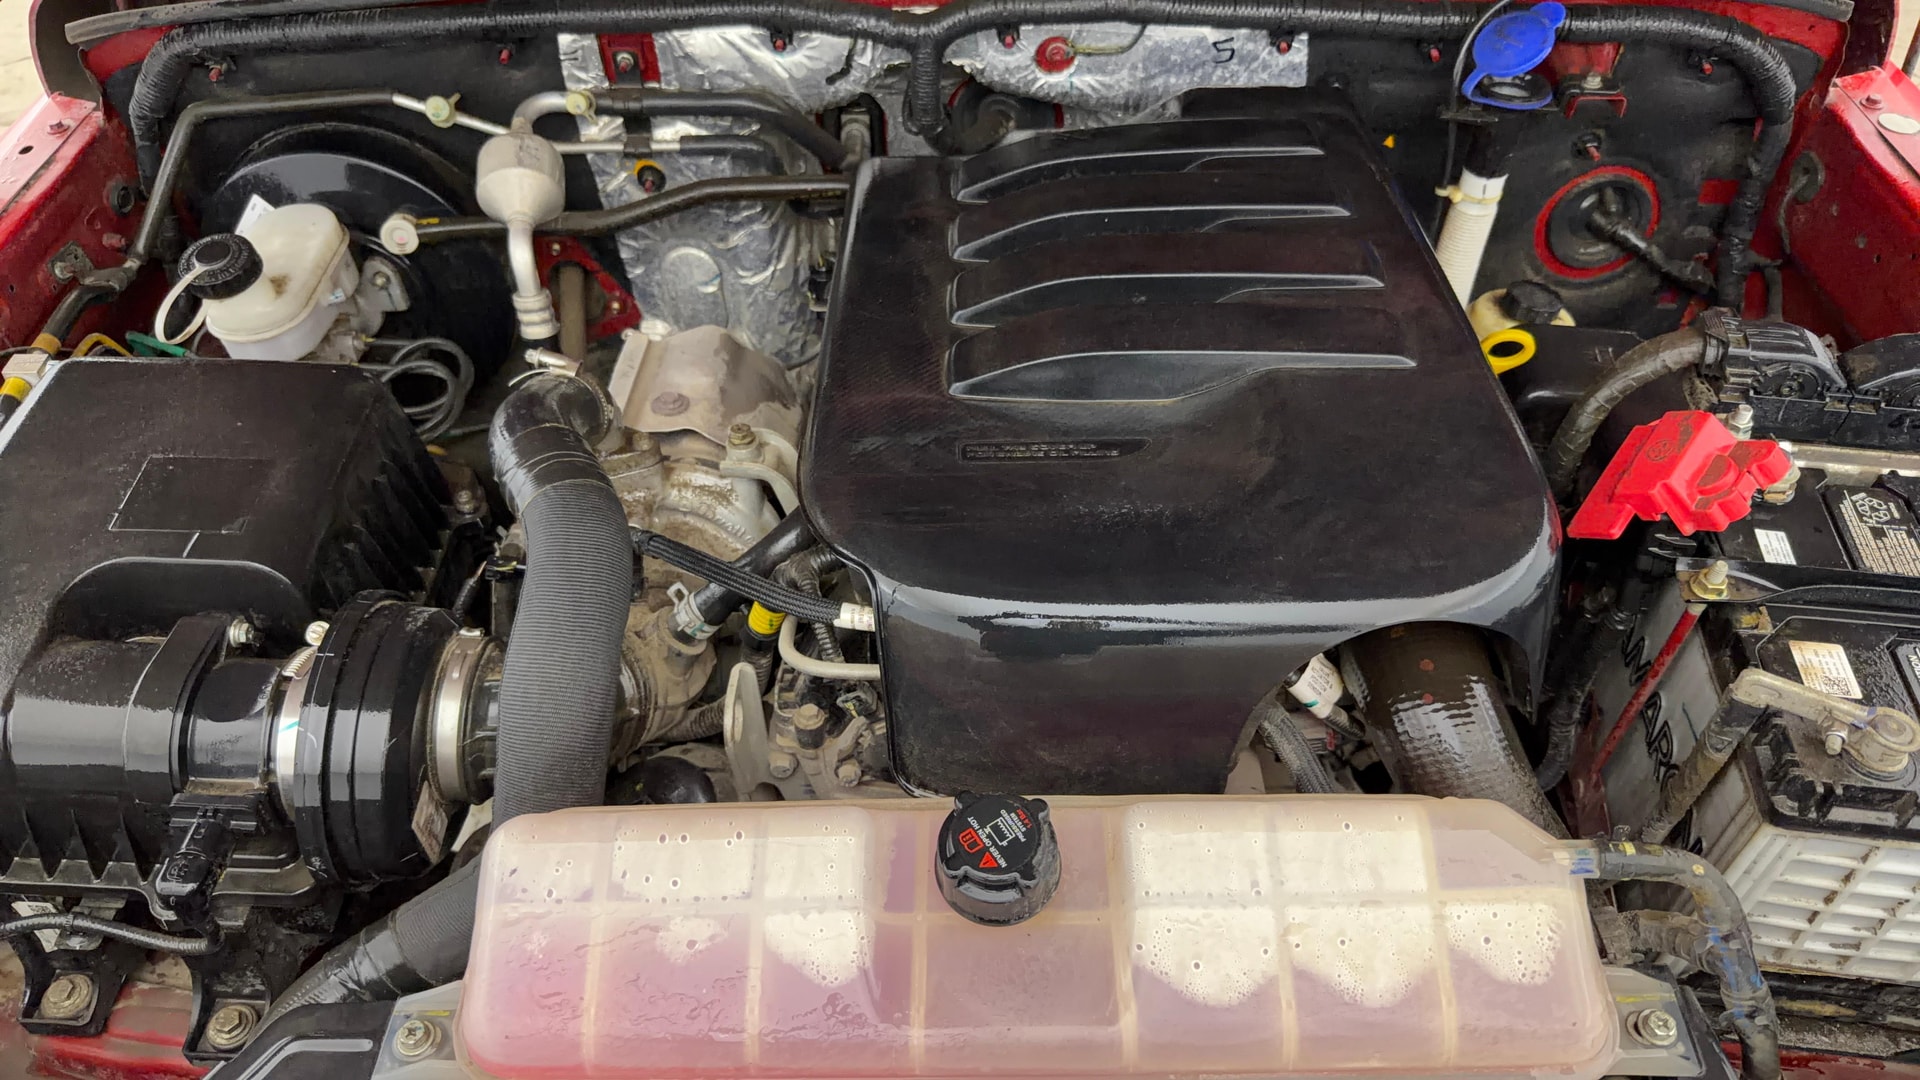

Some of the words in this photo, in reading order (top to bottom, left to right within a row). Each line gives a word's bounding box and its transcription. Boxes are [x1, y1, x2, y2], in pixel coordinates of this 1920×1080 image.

[1212, 36, 1235, 64] 5
[967, 816, 980, 830] HOT
[977, 828, 992, 847] OPEN
[989, 845, 1008, 868] NEVER
